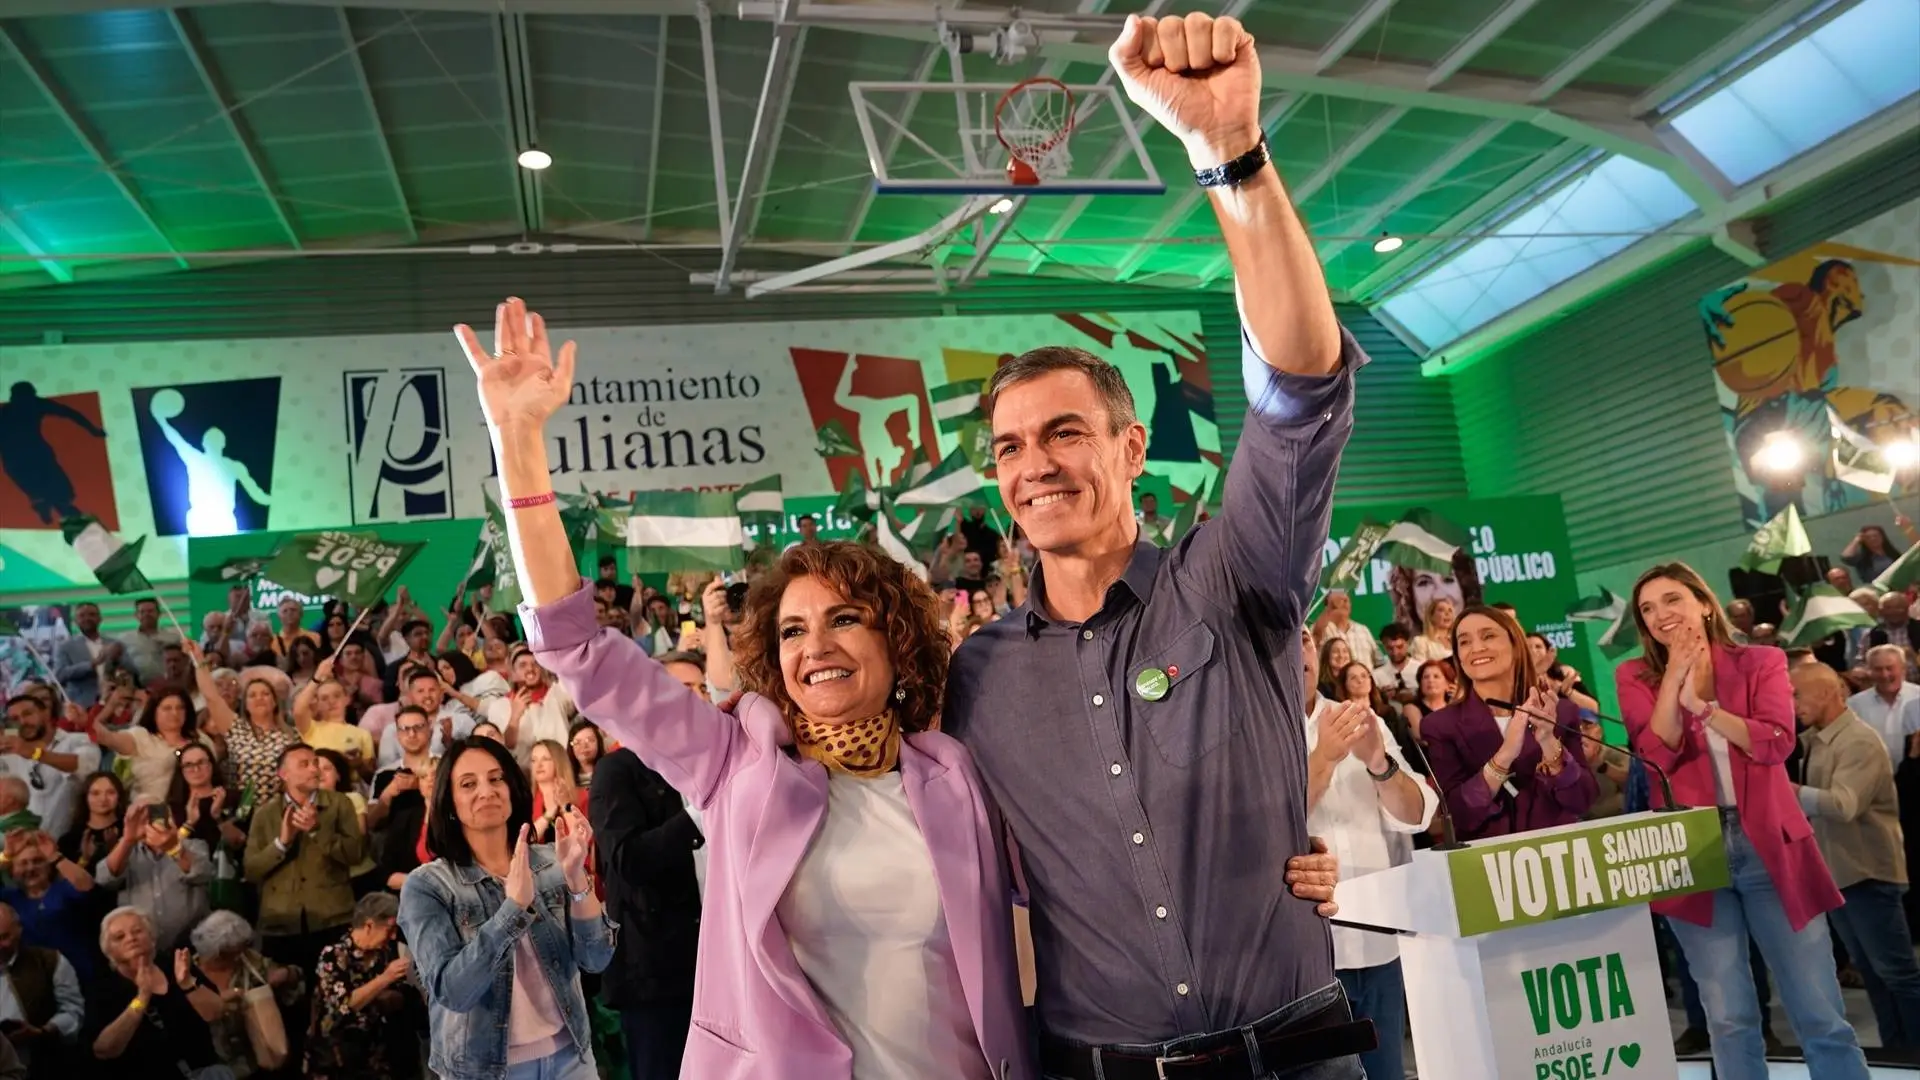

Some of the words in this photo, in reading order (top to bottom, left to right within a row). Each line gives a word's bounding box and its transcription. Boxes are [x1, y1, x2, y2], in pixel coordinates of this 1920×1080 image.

[569, 367, 761, 405] ntamiento
[637, 406, 666, 428] de
[484, 414, 766, 478] ulianas
[1475, 551, 1556, 585] PÚBLICO
[1546, 630, 1576, 649] SOE
[1481, 837, 1604, 922] VOTA
[1602, 821, 1688, 865] SANIDAD
[1607, 856, 1695, 901] PÚBLICA
[1520, 952, 1635, 1036] VOTA
[1533, 1036, 1593, 1059] Andalucía
[1535, 1052, 1597, 1080] PSOE
